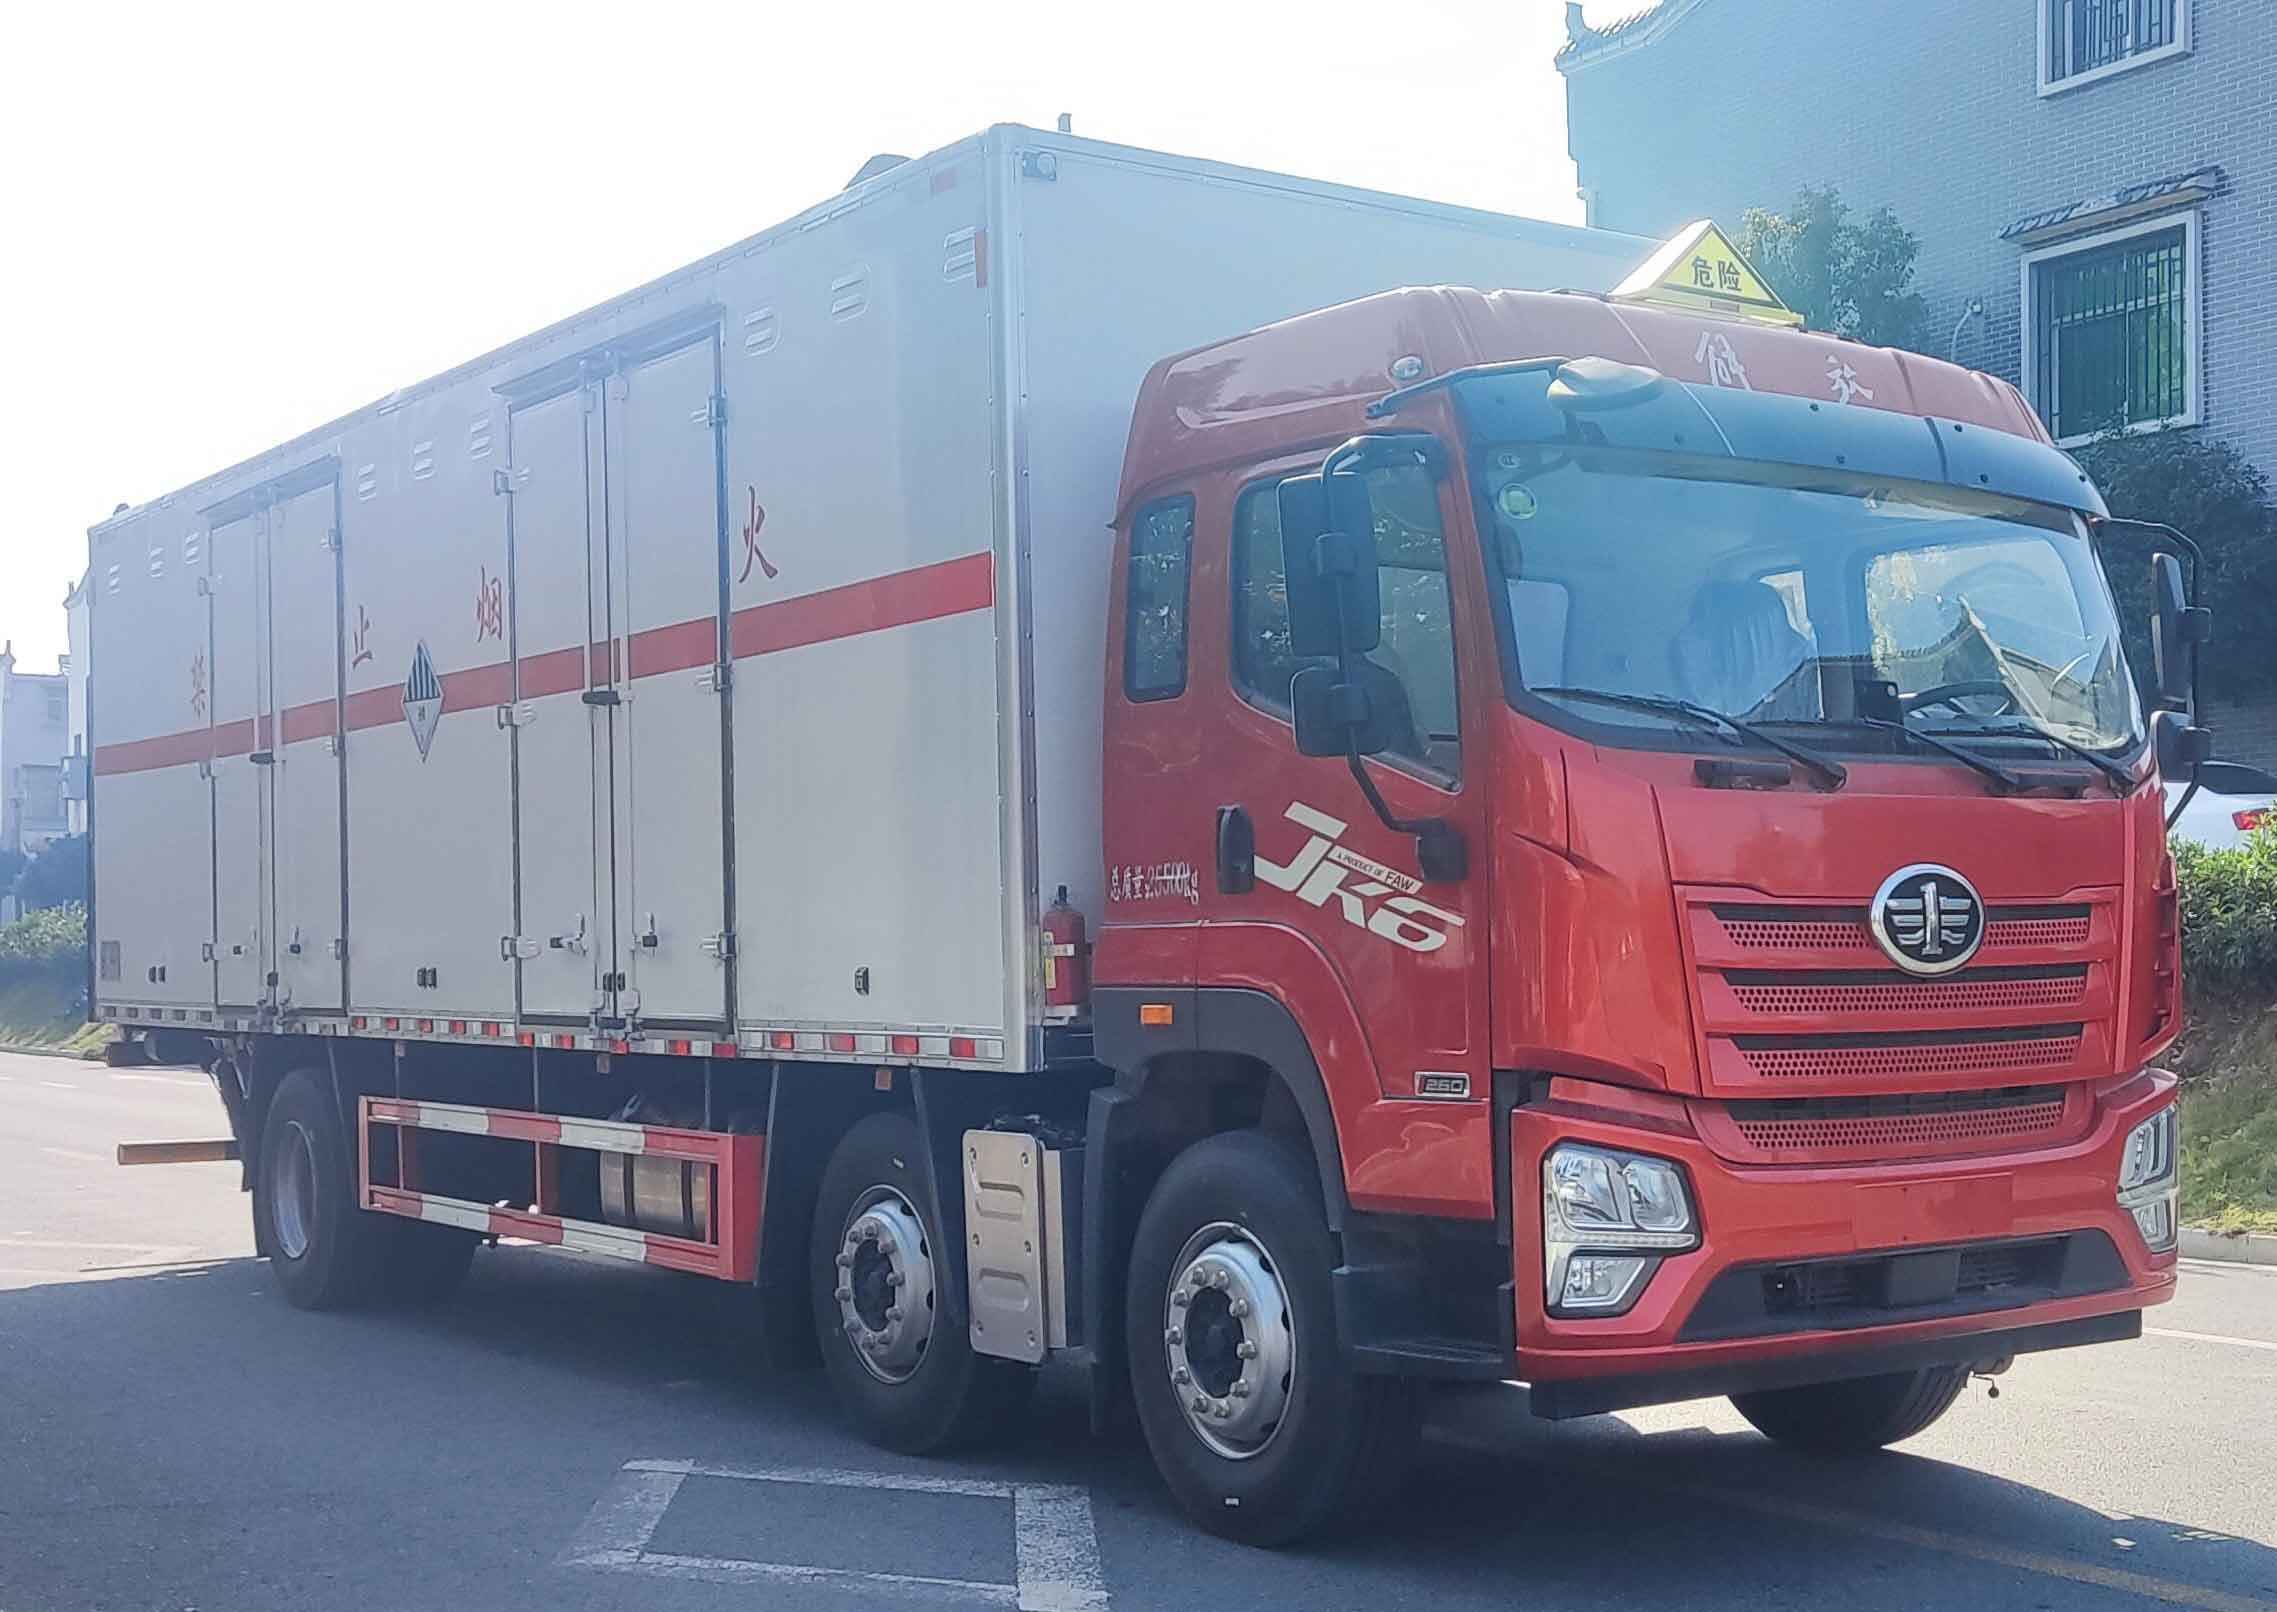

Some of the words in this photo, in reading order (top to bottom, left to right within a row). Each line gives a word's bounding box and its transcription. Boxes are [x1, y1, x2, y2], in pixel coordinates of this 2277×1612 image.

[1691, 256, 1742, 292] 危险
[352, 605, 374, 669] 止
[476, 565, 502, 642] 烟
[738, 485, 778, 583] 火
[1253, 801, 1465, 953] JK6
[1384, 870, 1415, 891] FAW
[1425, 1078, 1464, 1093] 260
